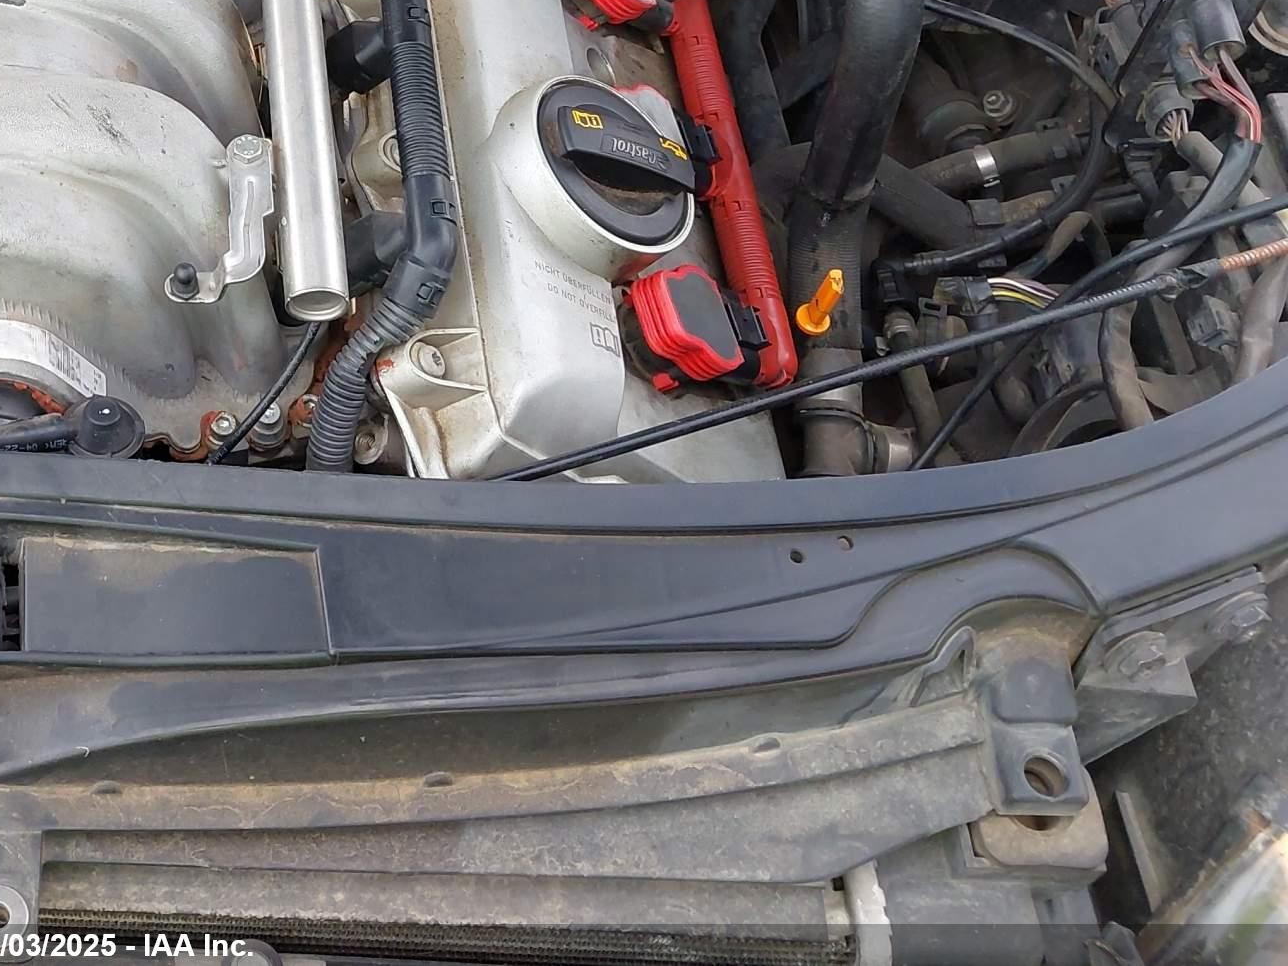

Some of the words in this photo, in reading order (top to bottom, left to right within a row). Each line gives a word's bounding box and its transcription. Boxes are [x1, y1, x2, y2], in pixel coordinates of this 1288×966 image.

[612, 137, 656, 164] Castrol
[547, 283, 559, 294] DO
[561, 289, 577, 305] NOT
